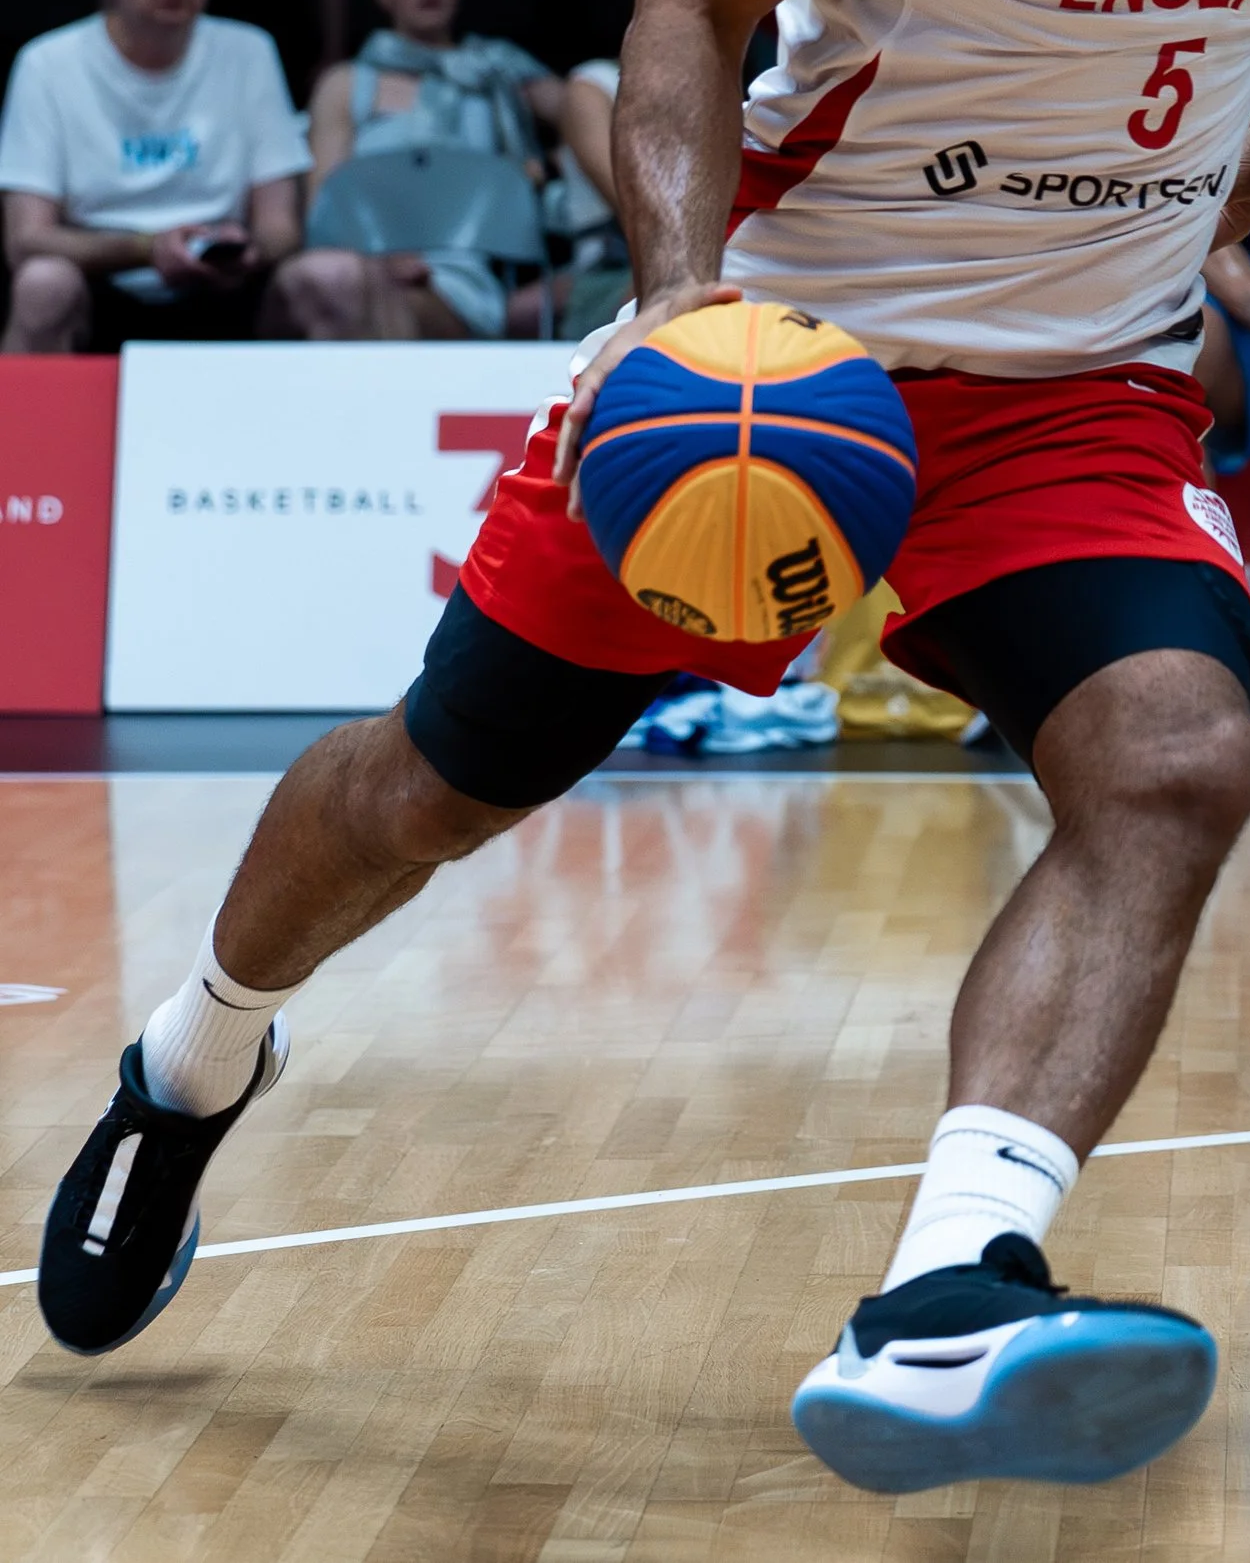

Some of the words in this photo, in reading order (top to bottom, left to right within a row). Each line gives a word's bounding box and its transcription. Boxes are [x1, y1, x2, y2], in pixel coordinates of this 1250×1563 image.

[1127, 37, 1208, 150] 5
[0, 494, 64, 526] ND
[167, 487, 424, 516] BASKETBALL
